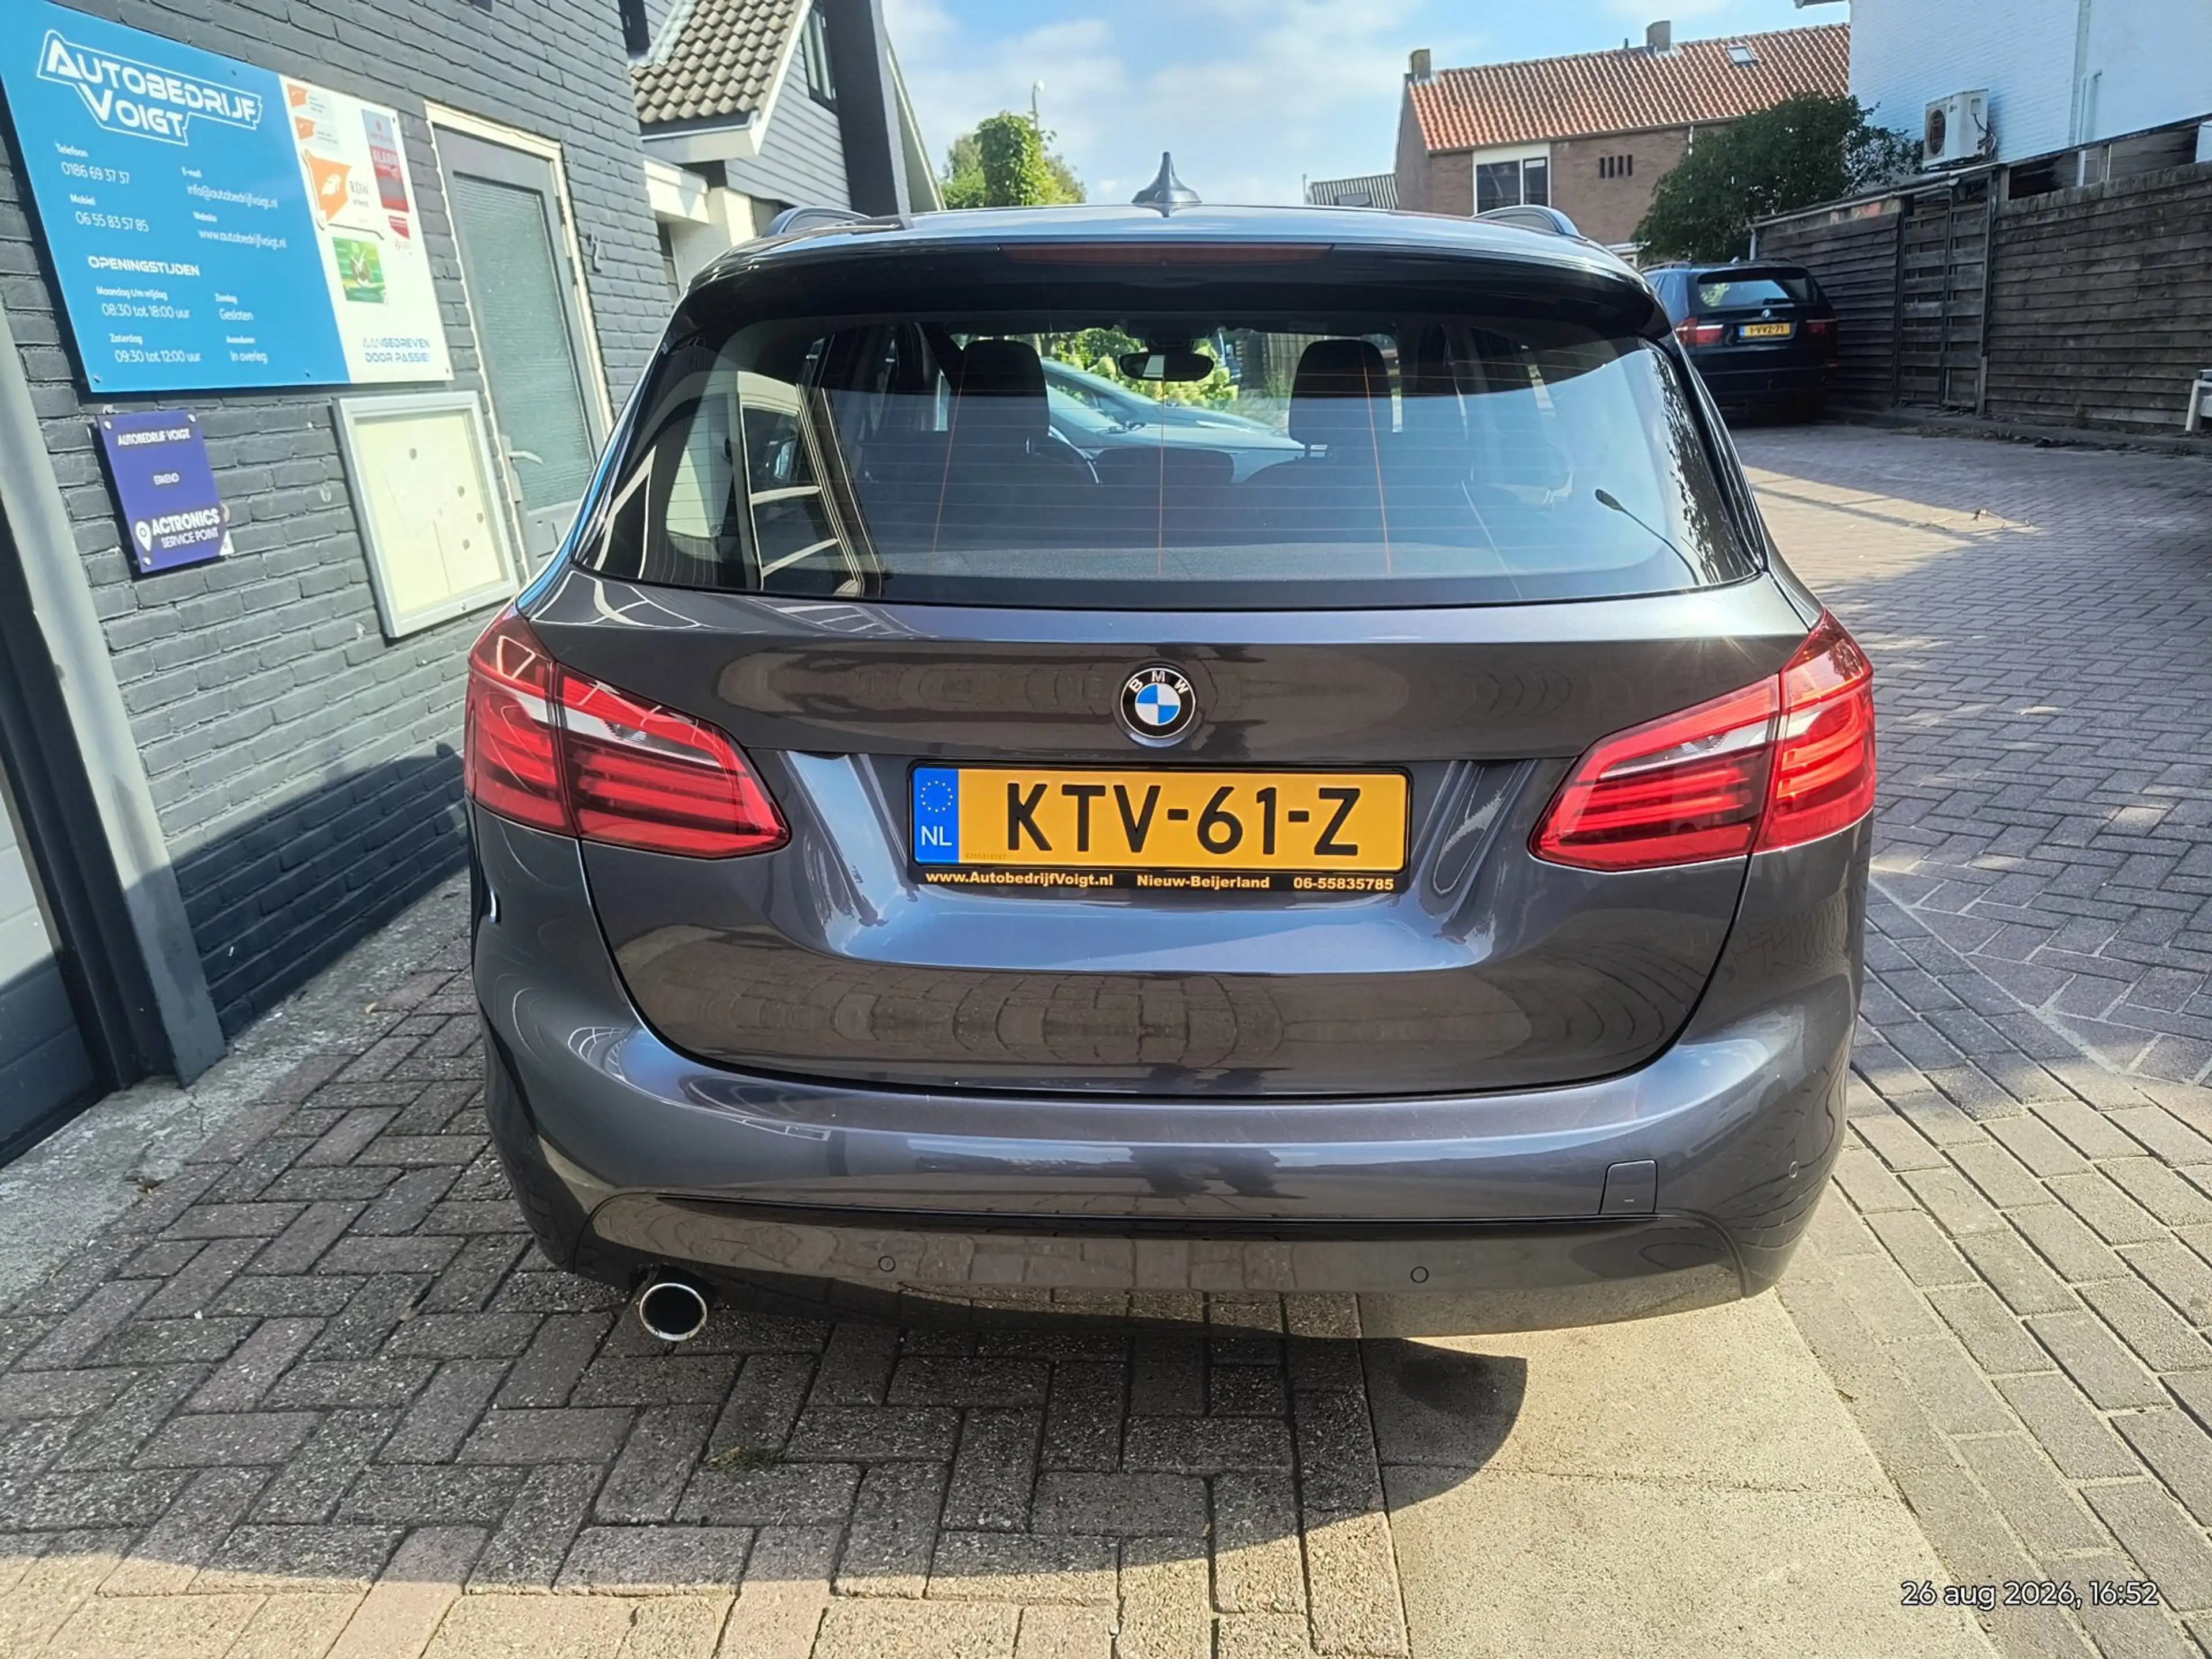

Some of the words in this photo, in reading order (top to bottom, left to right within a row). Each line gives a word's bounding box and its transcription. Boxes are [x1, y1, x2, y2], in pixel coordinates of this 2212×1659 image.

[47, 40, 257, 122] AUTOBEDRIJF
[78, 82, 183, 137] VOIGT
[61, 161, 88, 178] 0186
[89, 166, 104, 181] 69
[104, 168, 116, 182] 37
[118, 171, 130, 184] 37
[75, 210, 92, 225] 06
[92, 213, 107, 227] 55
[107, 214, 121, 229] 83
[121, 217, 133, 230] 57
[135, 218, 149, 232] 85
[87, 255, 200, 276] OPENINGSTIJDEN
[101, 302, 132, 317] 08:30
[132, 305, 149, 317] tot
[148, 305, 175, 319] 18:00
[175, 309, 190, 319] uur
[219, 308, 254, 321] Gesloten
[108, 332, 143, 346] Zaterdag
[362, 337, 430, 349] AANGEDREVEN
[115, 350, 144, 363] 09:30
[145, 351, 161, 362] tot
[160, 350, 186, 362] 12:00
[186, 353, 201, 362] uur
[238, 349, 268, 365] overleg
[365, 352, 393, 363] DOOR
[118, 431, 166, 446] AUTOBEDRIJF
[165, 427, 191, 441] VOIGT
[151, 507, 221, 536] ACTRONICS
[161, 532, 196, 549] SERVICE
[195, 527, 219, 541] POINT
[1128, 669, 1190, 694] BMW
[1006, 782, 1362, 857] KTV-61-Z
[922, 825, 953, 847] NL
[925, 871, 1114, 888] www.AutobedrijfVoigt.nl
[1137, 874, 1271, 891] Nieuw-Beijerland
[1293, 877, 1395, 890] 06-55835785
